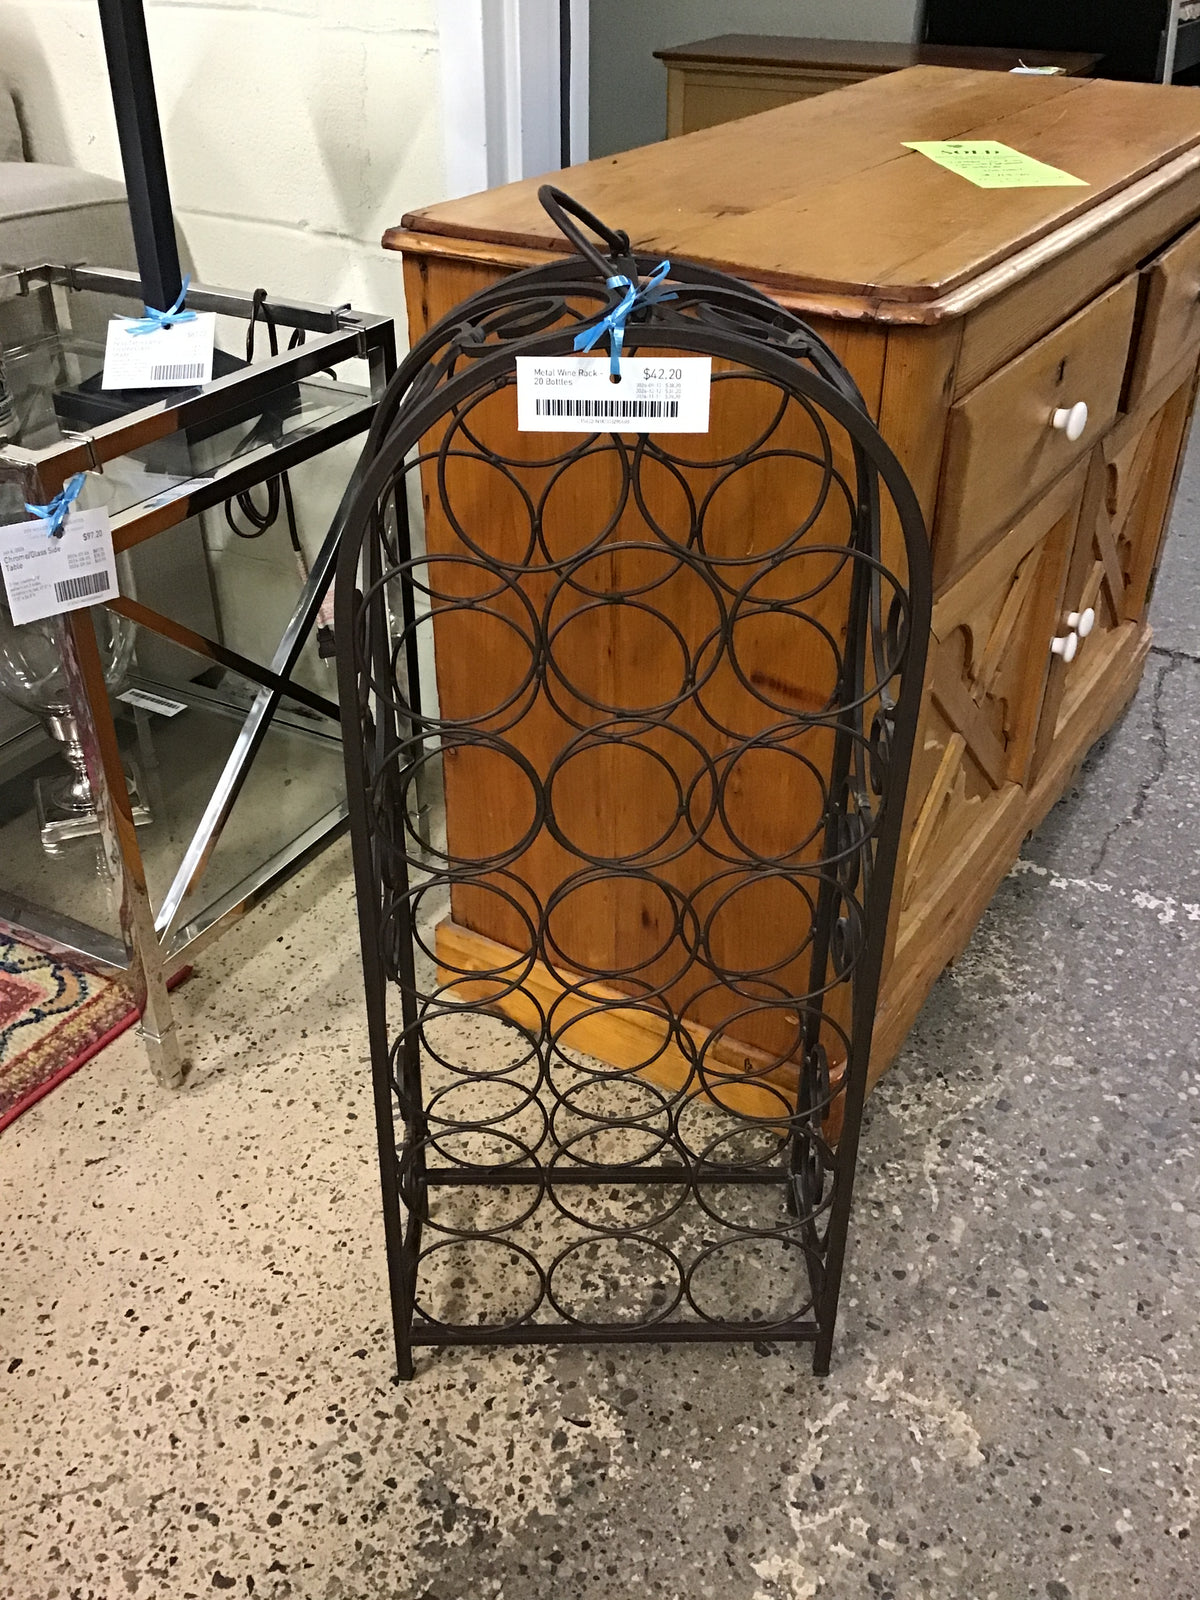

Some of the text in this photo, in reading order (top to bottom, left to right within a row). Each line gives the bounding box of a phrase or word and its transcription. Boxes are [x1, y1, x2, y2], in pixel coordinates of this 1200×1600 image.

[534, 368, 556, 377] Metal
[557, 368, 576, 377] Wine
[578, 368, 598, 377] Rack
[643, 368, 682, 381] $42.20
[534, 378, 573, 386] 20 Bottles
[82, 529, 103, 541] $97.20
[4, 550, 47, 564] Chrome/Glass
[48, 546, 61, 555] Side
[5, 563, 23, 571] Table
